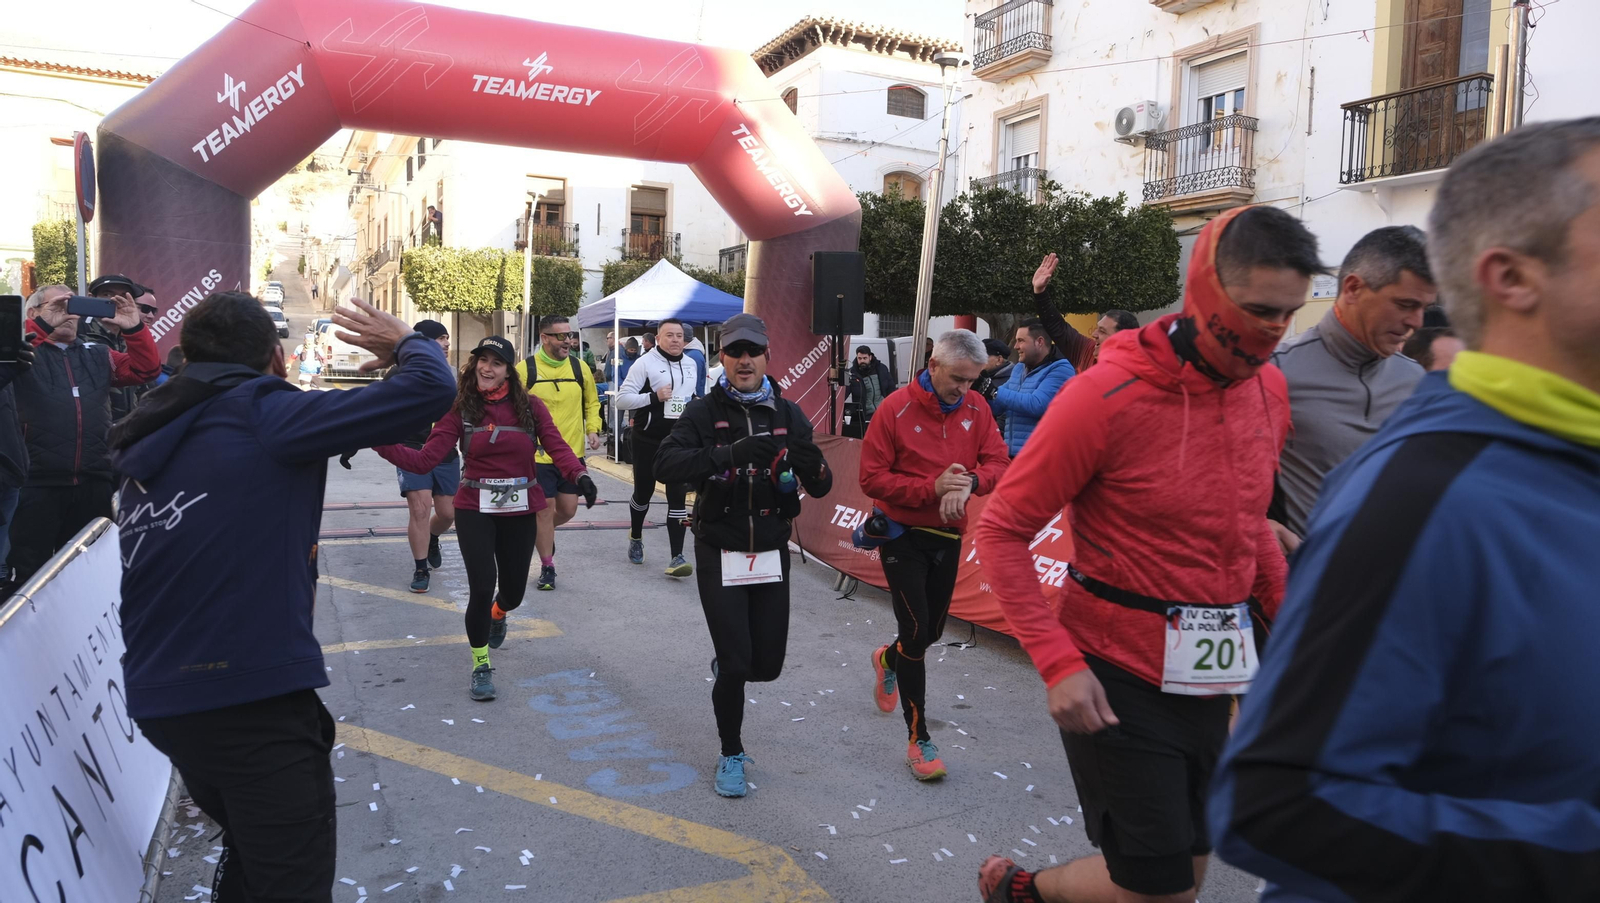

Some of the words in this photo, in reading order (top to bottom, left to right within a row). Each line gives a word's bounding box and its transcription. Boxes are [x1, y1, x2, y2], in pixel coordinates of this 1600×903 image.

[472, 74, 602, 107] TEAMERGY
[192, 63, 306, 163] TEAMERGY
[731, 124, 813, 218] TEAMERGY
[490, 490, 519, 503] 26
[746, 554, 757, 571] 7
[1181, 622, 1194, 631] LA
[1186, 609, 1199, 620] IV
[20, 654, 134, 903] CANTO
